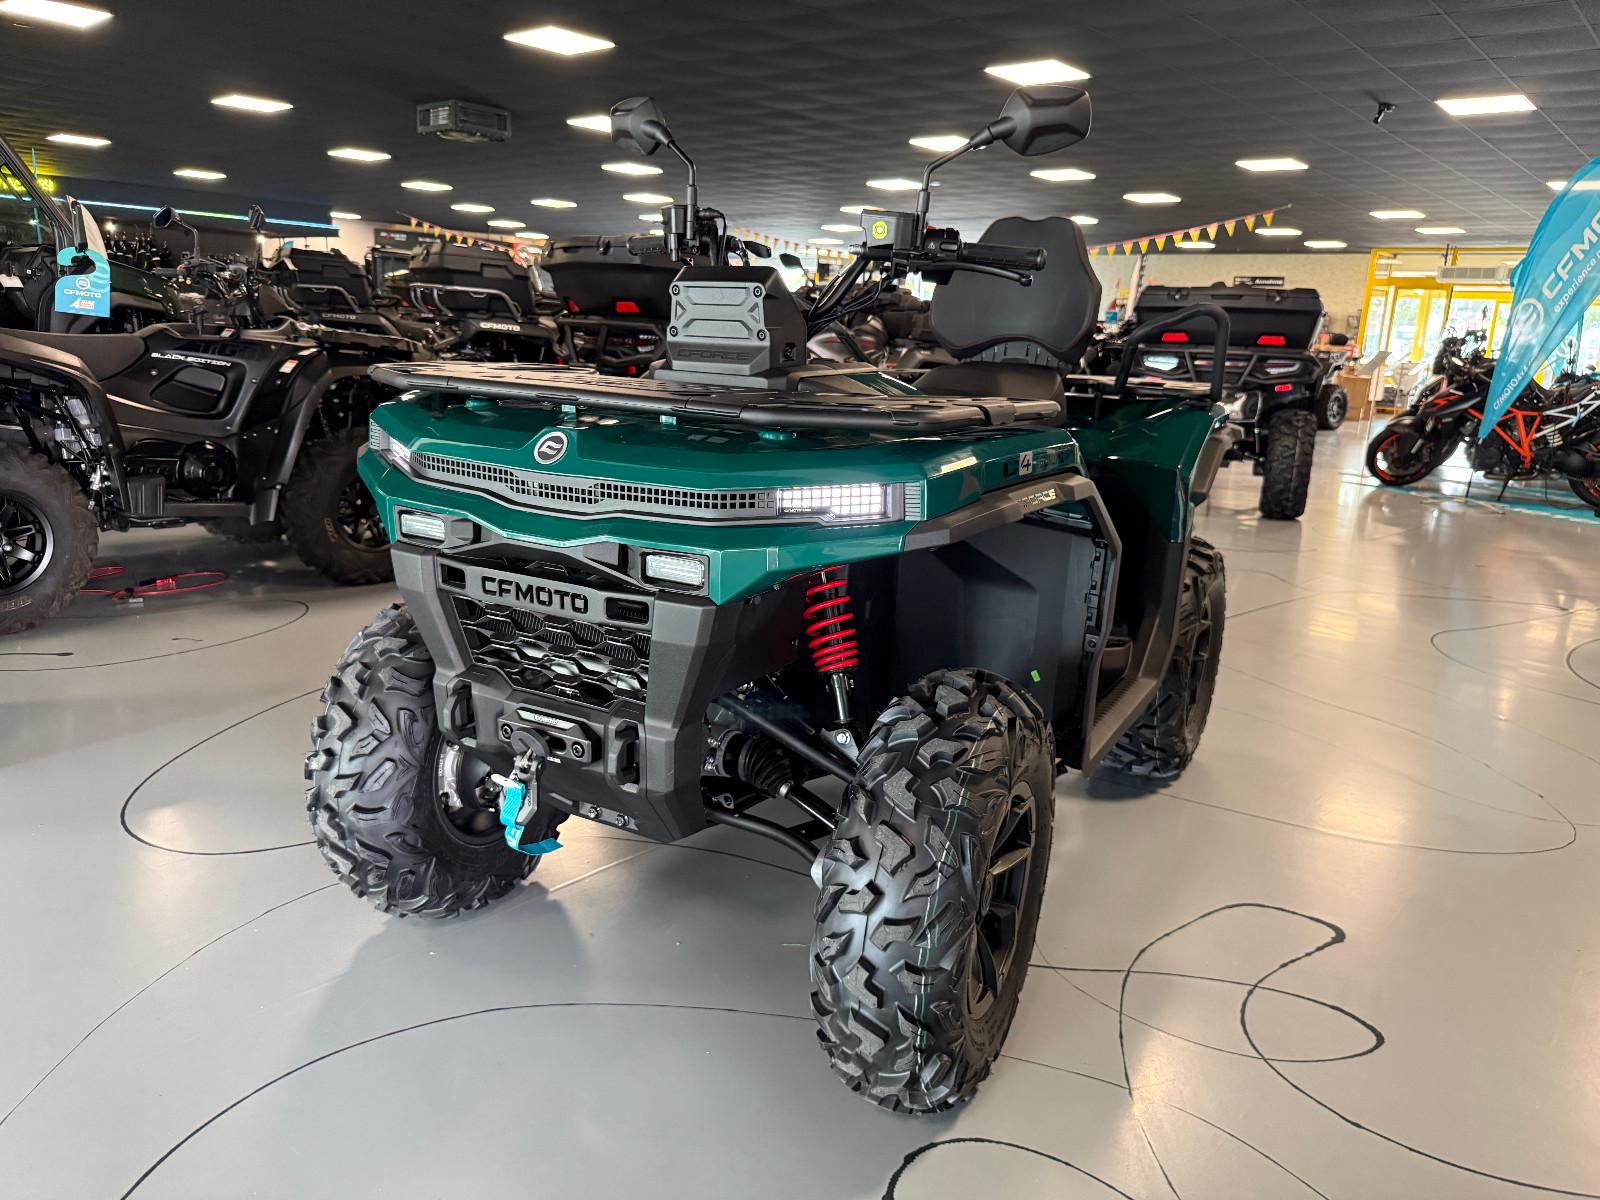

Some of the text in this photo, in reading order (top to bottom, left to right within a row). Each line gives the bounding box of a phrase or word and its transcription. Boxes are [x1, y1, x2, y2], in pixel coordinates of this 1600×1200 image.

[1554, 258, 1596, 312] experience
[64, 289, 101, 298] CFMOTO
[479, 321, 521, 331] CFMOTO
[151, 352, 232, 367] BLACK EDITION
[481, 575, 589, 614] CFMOTO
